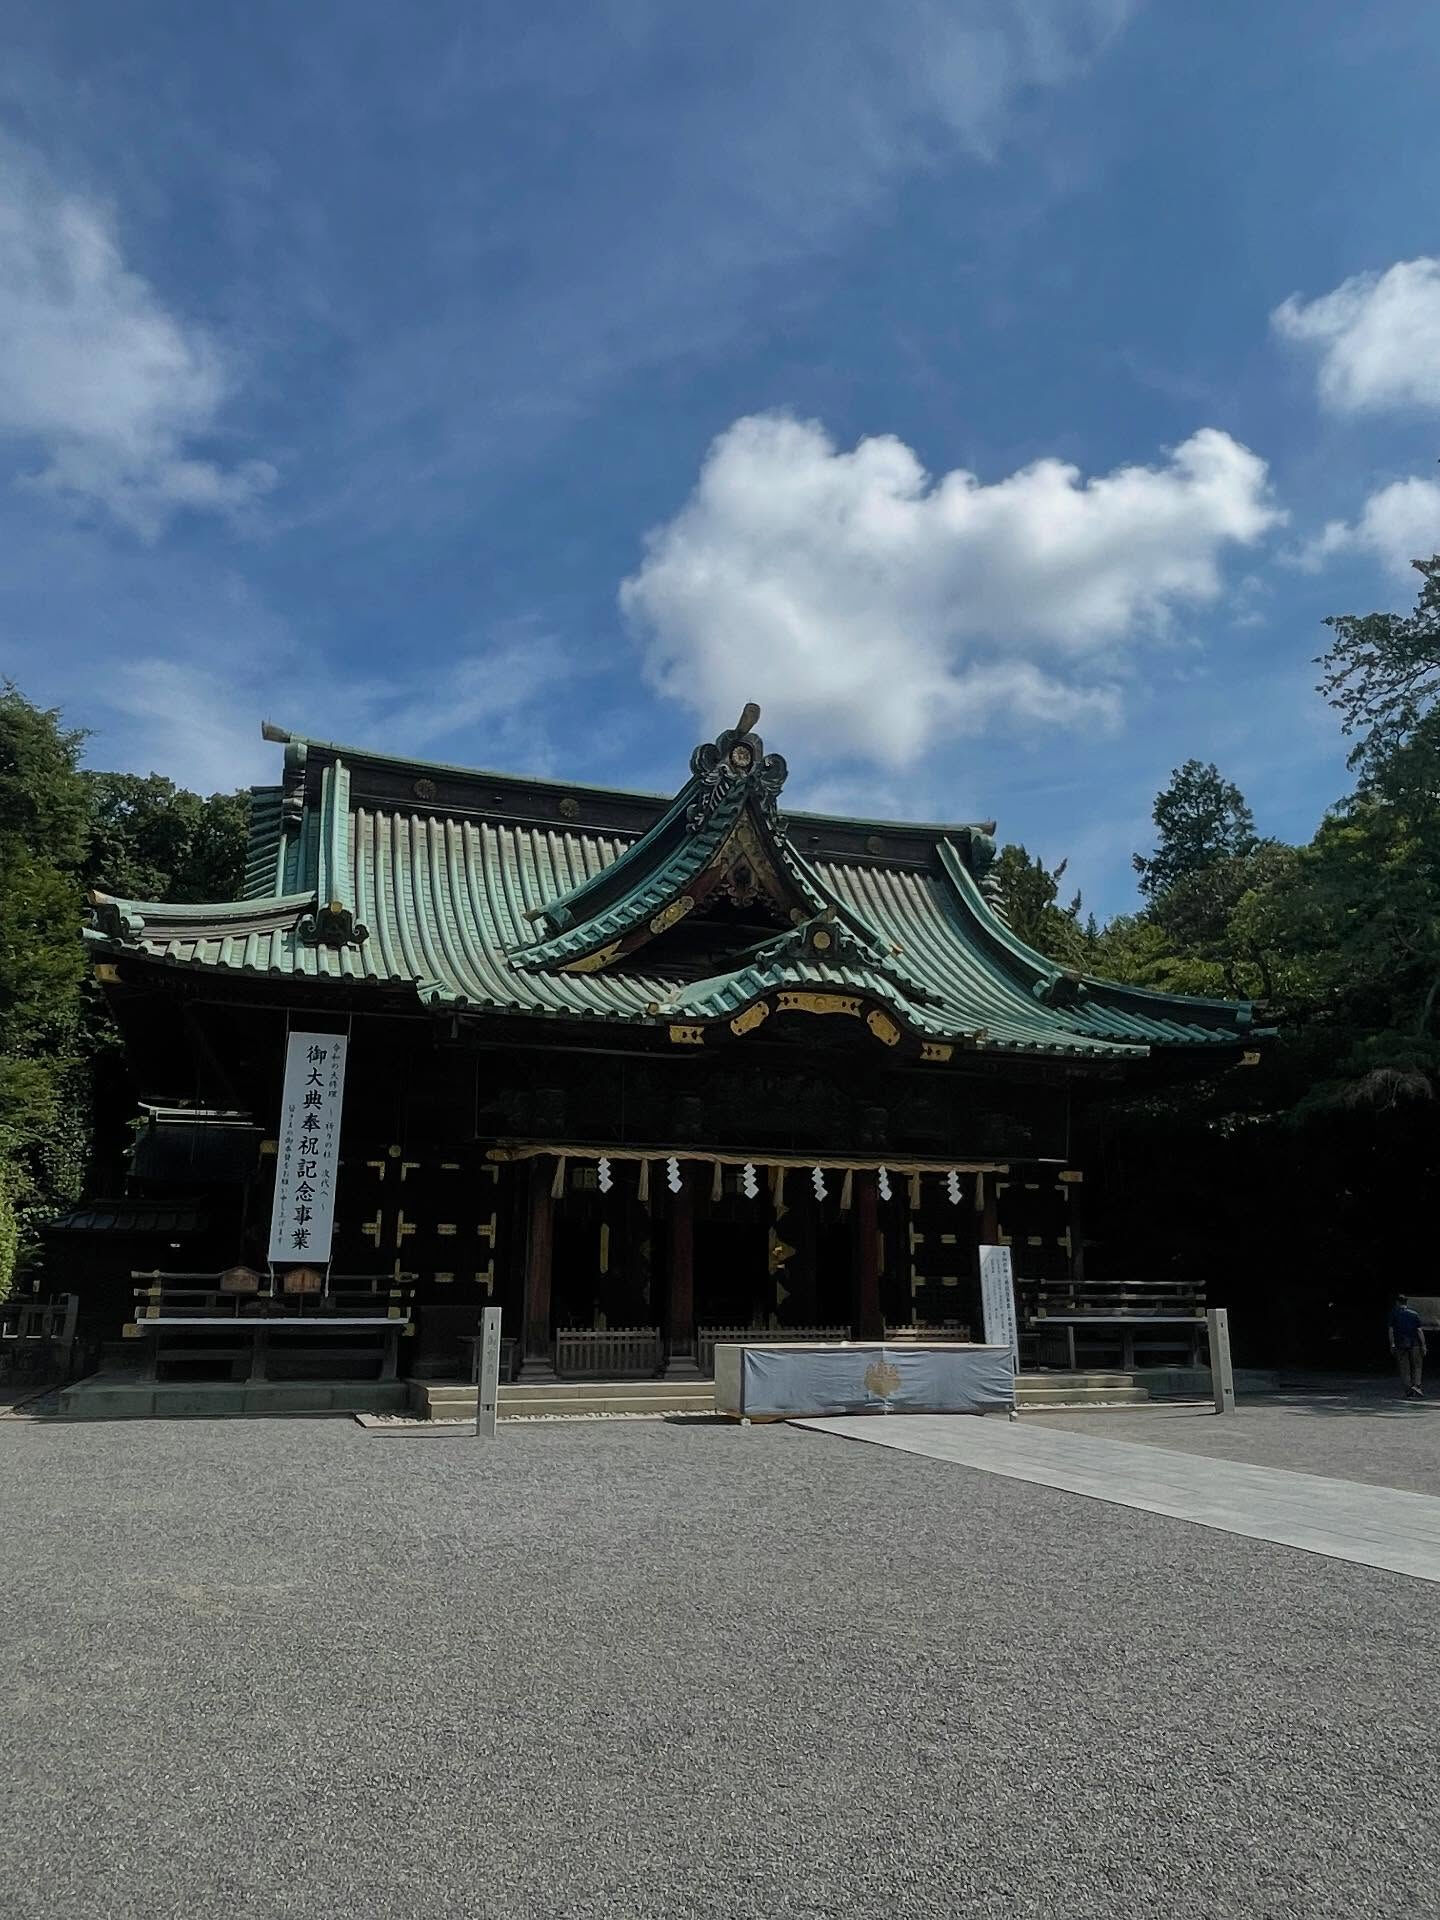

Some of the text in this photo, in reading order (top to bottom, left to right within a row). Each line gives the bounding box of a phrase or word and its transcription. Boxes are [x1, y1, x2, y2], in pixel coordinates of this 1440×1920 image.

[291, 1044, 328, 1250] 御大典奉祝記念事業
